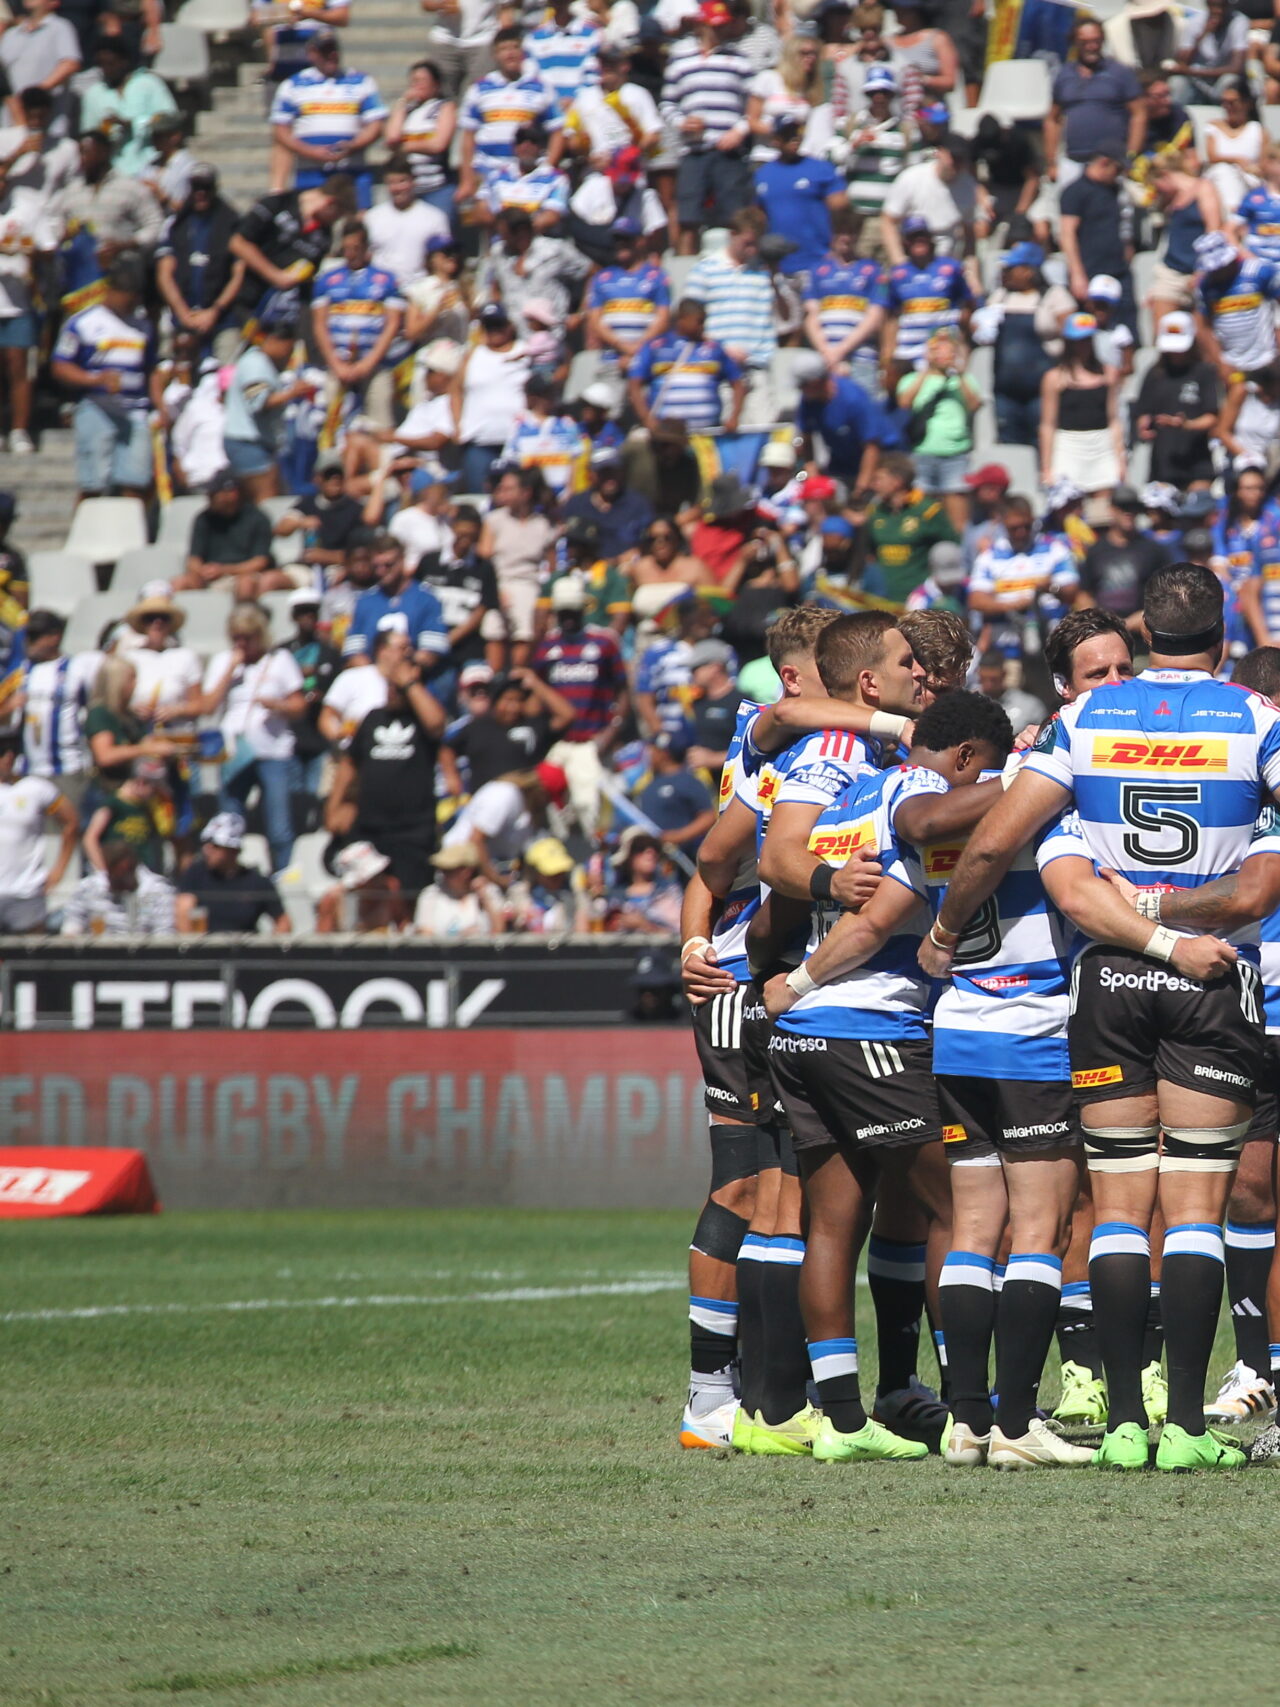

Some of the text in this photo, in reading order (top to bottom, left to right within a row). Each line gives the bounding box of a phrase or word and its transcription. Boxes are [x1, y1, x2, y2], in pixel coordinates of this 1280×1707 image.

[1090, 708, 1138, 717] JETOUR
[1191, 710, 1243, 719] JETOUR
[1108, 742, 1208, 766] DHL
[1119, 782, 1202, 868] 5
[1073, 1070, 1116, 1086] DHL
[106, 1072, 359, 1171] RUGBY
